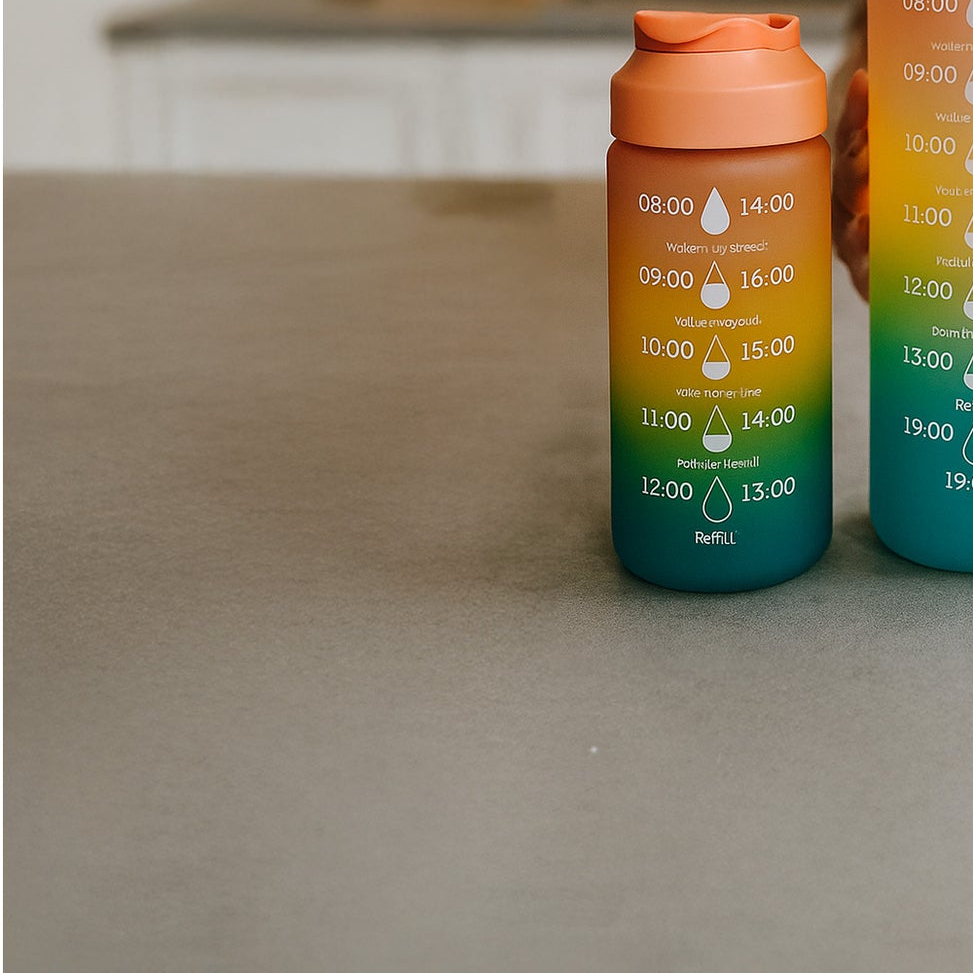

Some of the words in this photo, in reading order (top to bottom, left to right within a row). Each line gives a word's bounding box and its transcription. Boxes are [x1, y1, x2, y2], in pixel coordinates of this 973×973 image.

[903, 62, 958, 84] 09:00
[905, 133, 957, 155] 10:00
[638, 193, 694, 216] 08:00
[740, 192, 794, 216] 14:00
[903, 204, 952, 228] 11:00
[639, 266, 694, 289] 09:00
[740, 264, 794, 289] 16:00
[903, 275, 953, 301] 12:00
[641, 336, 694, 360] 10:00
[741, 335, 795, 361] 15:00
[903, 345, 953, 371] 13:00
[641, 407, 692, 431] 11:00
[742, 405, 795, 431] 14:00
[904, 416, 954, 442] 19:00
[641, 476, 693, 501] 12:00
[742, 477, 796, 502] 13:00
